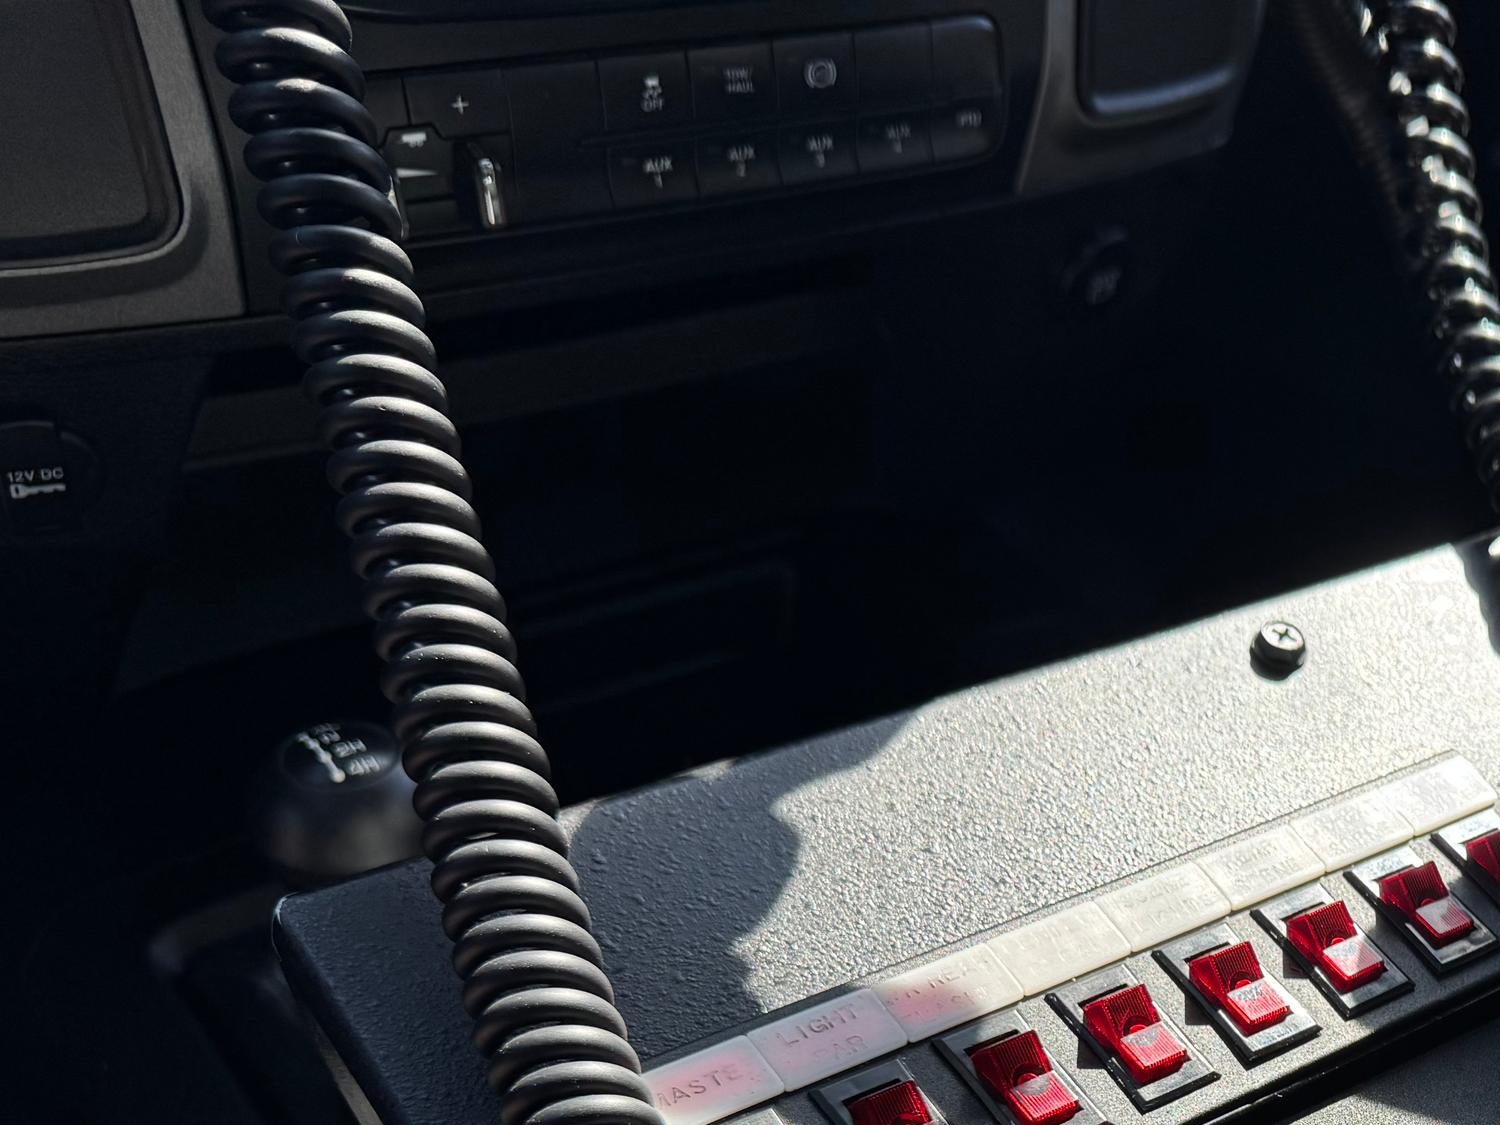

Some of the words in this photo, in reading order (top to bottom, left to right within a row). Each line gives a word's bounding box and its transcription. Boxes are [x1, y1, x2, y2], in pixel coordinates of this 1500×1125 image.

[640, 97, 664, 112] OFF
[643, 155, 673, 174] AUX
[8, 469, 35, 482] 12V
[40, 466, 64, 480] DC
[776, 1003, 857, 1047] LIGHT
